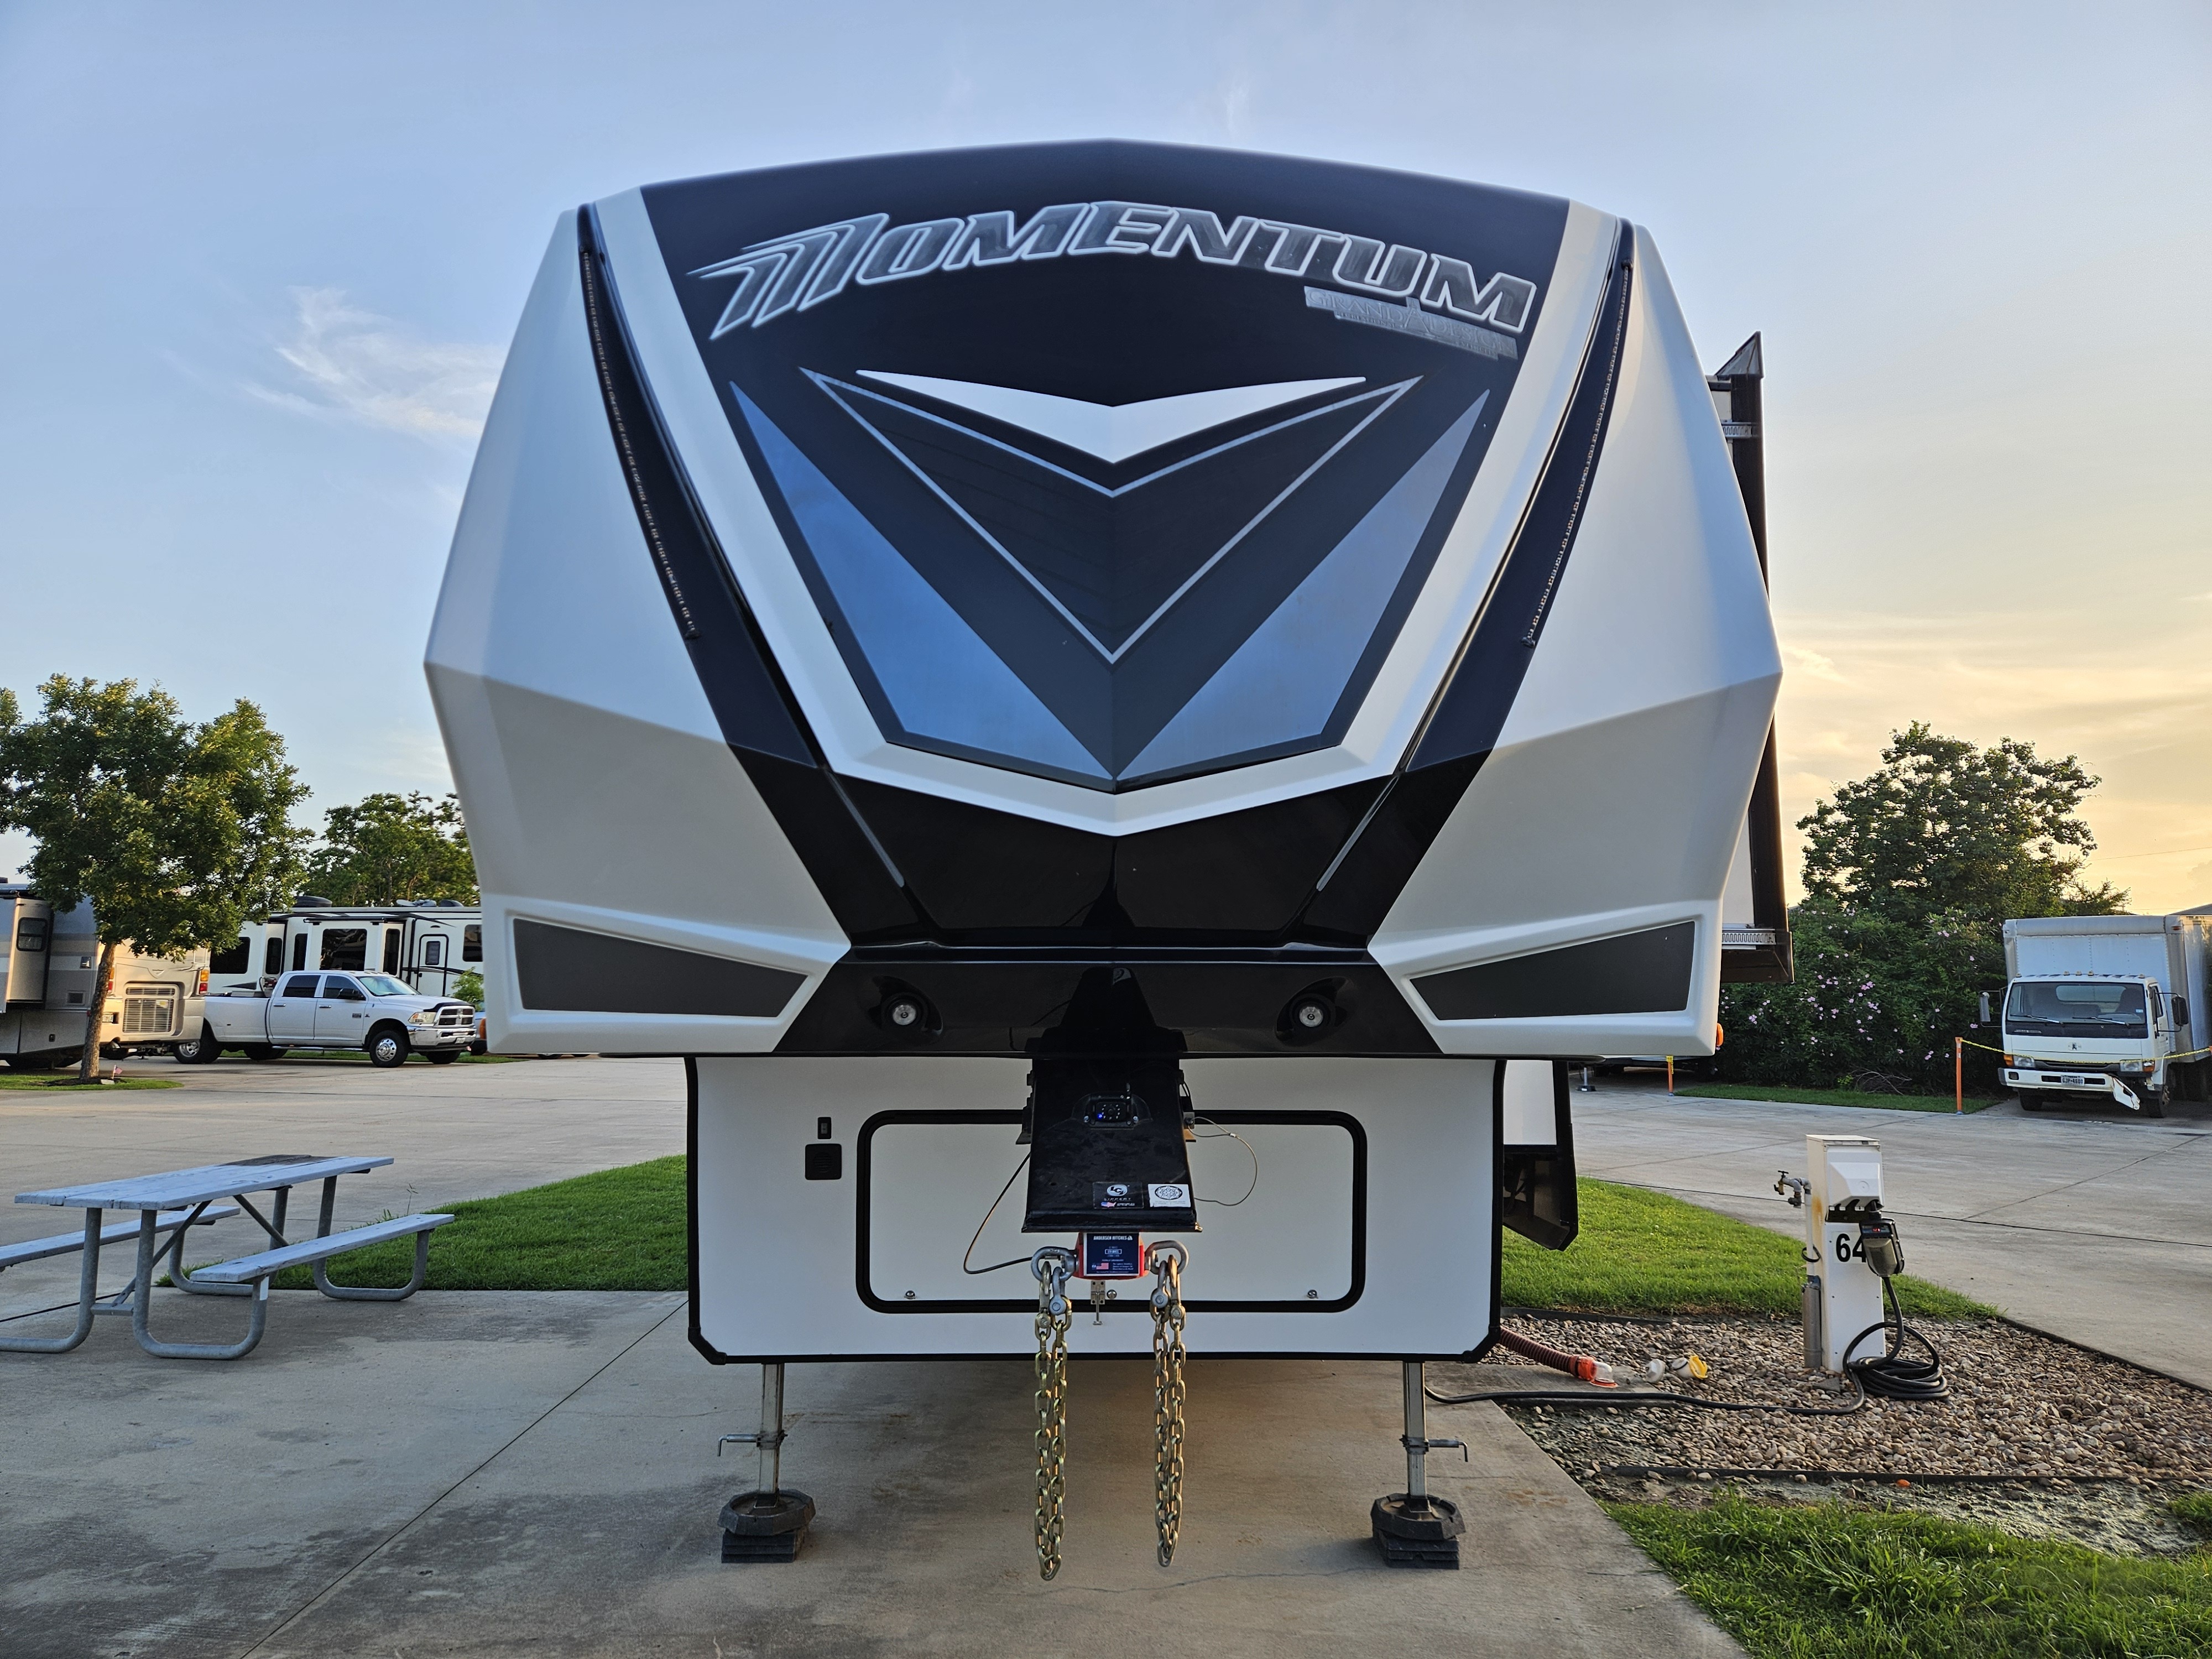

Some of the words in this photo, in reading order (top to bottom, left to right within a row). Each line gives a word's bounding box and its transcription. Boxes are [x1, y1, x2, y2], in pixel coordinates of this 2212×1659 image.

[686, 200, 1537, 341] MOMENTUM
[1306, 289, 1405, 322] GRAND
[1427, 314, 1516, 356] DESIGN
[1836, 1233, 1867, 1262] 64
